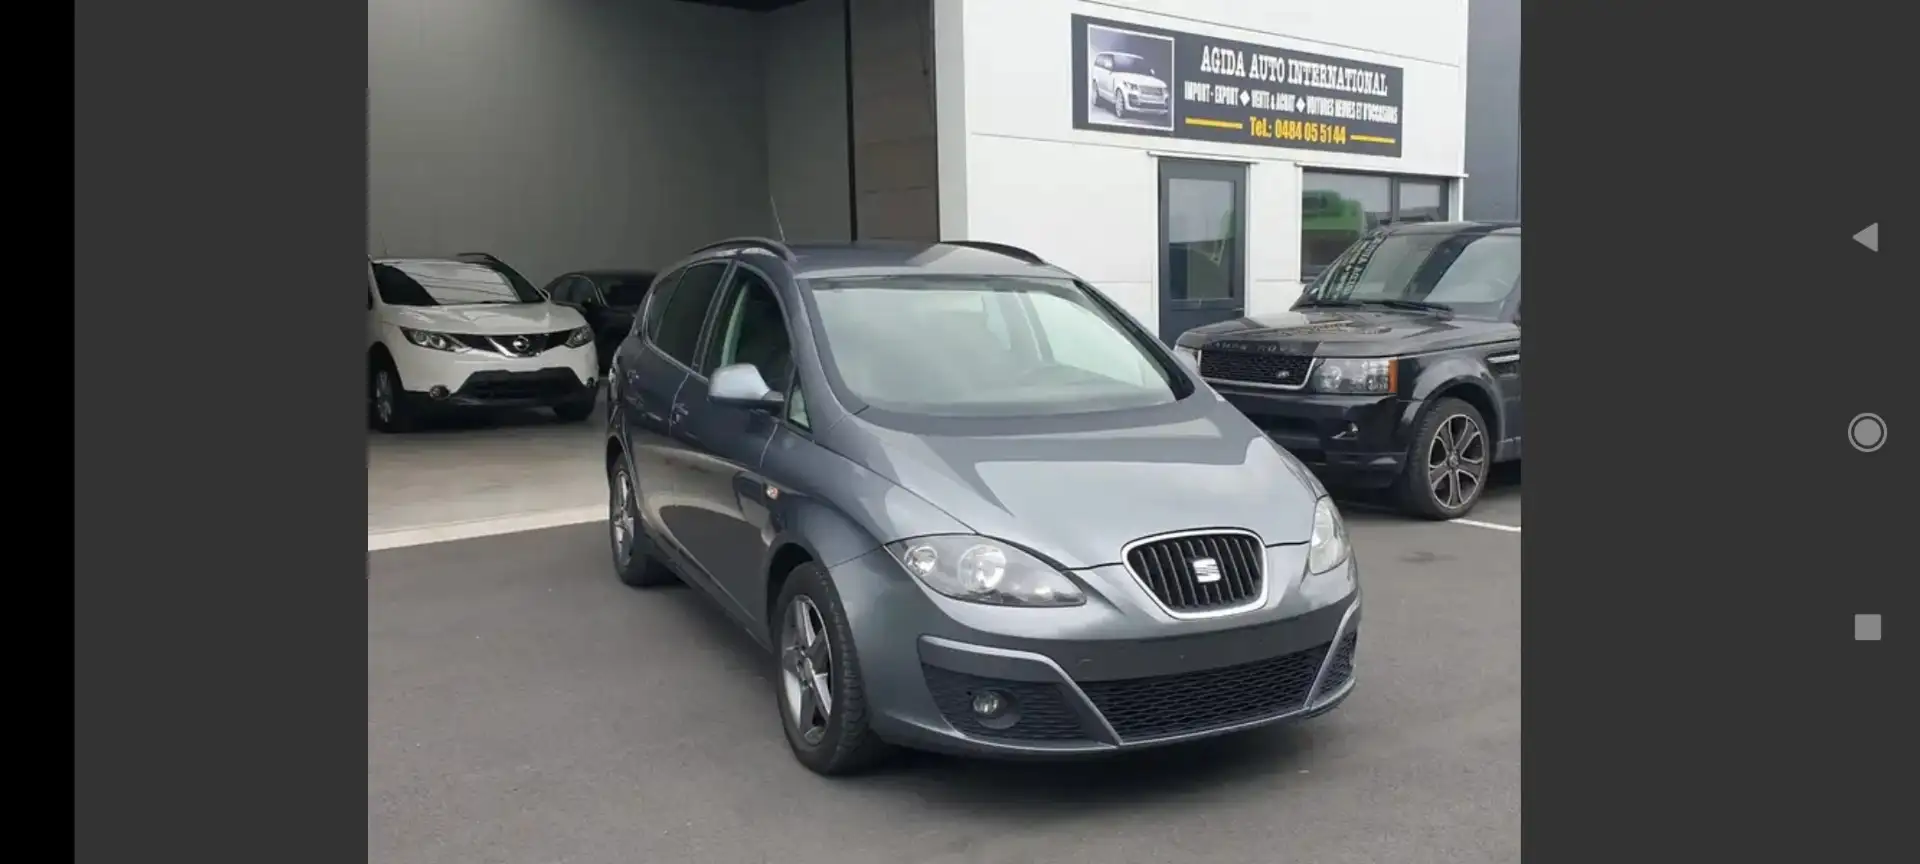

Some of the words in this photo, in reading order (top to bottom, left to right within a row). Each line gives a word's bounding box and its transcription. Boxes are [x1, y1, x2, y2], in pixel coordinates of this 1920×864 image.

[1200, 45, 1246, 77] AGIDA
[1249, 53, 1285, 83] AUTO
[1287, 58, 1388, 97] INTERNATIONAL
[1184, 80, 1211, 103] IMPORT
[1214, 84, 1240, 106] EXPORT
[1275, 119, 1303, 141] 0484
[1305, 121, 1318, 142] 05
[1320, 124, 1346, 145] 5144
